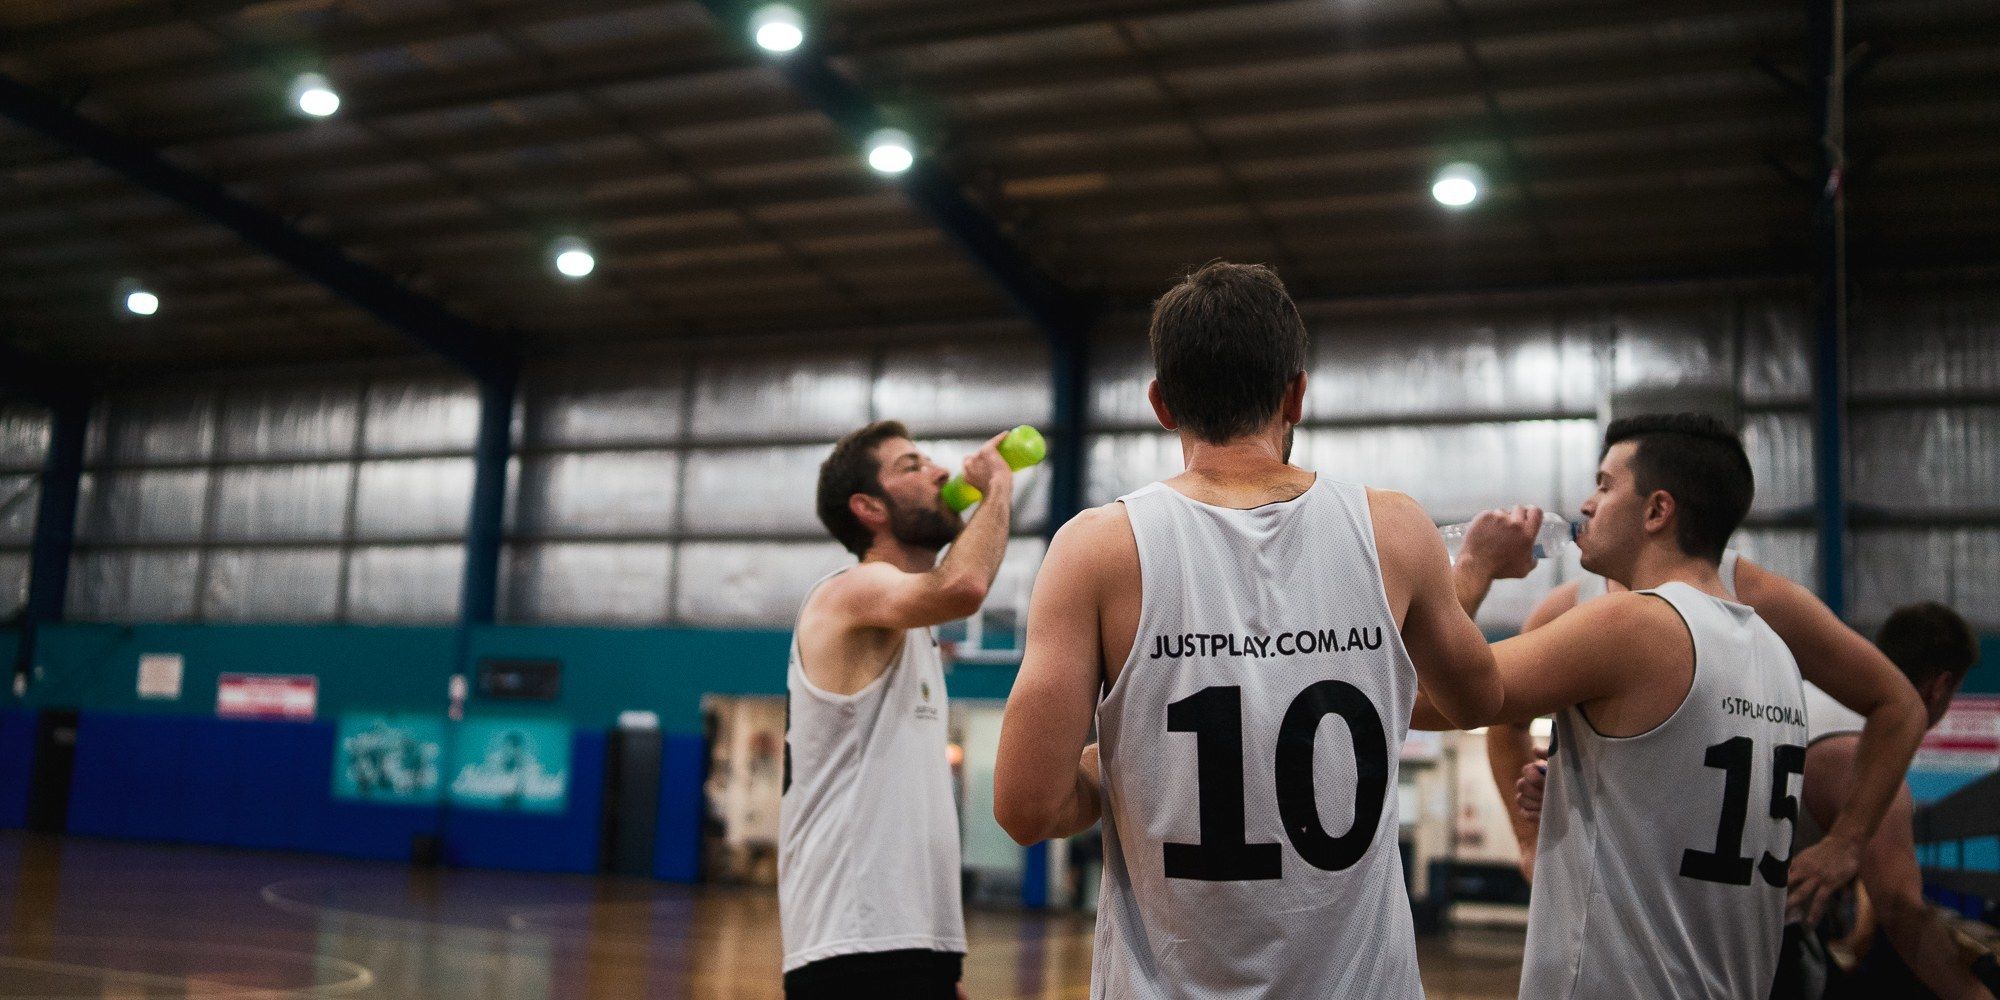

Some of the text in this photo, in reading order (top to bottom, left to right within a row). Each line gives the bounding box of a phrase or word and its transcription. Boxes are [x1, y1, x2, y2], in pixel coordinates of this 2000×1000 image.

[1150, 626, 1383, 659] JUSTPLAY.COM.AU
[1163, 679, 1389, 881] 10
[1679, 735, 1807, 888] 15
